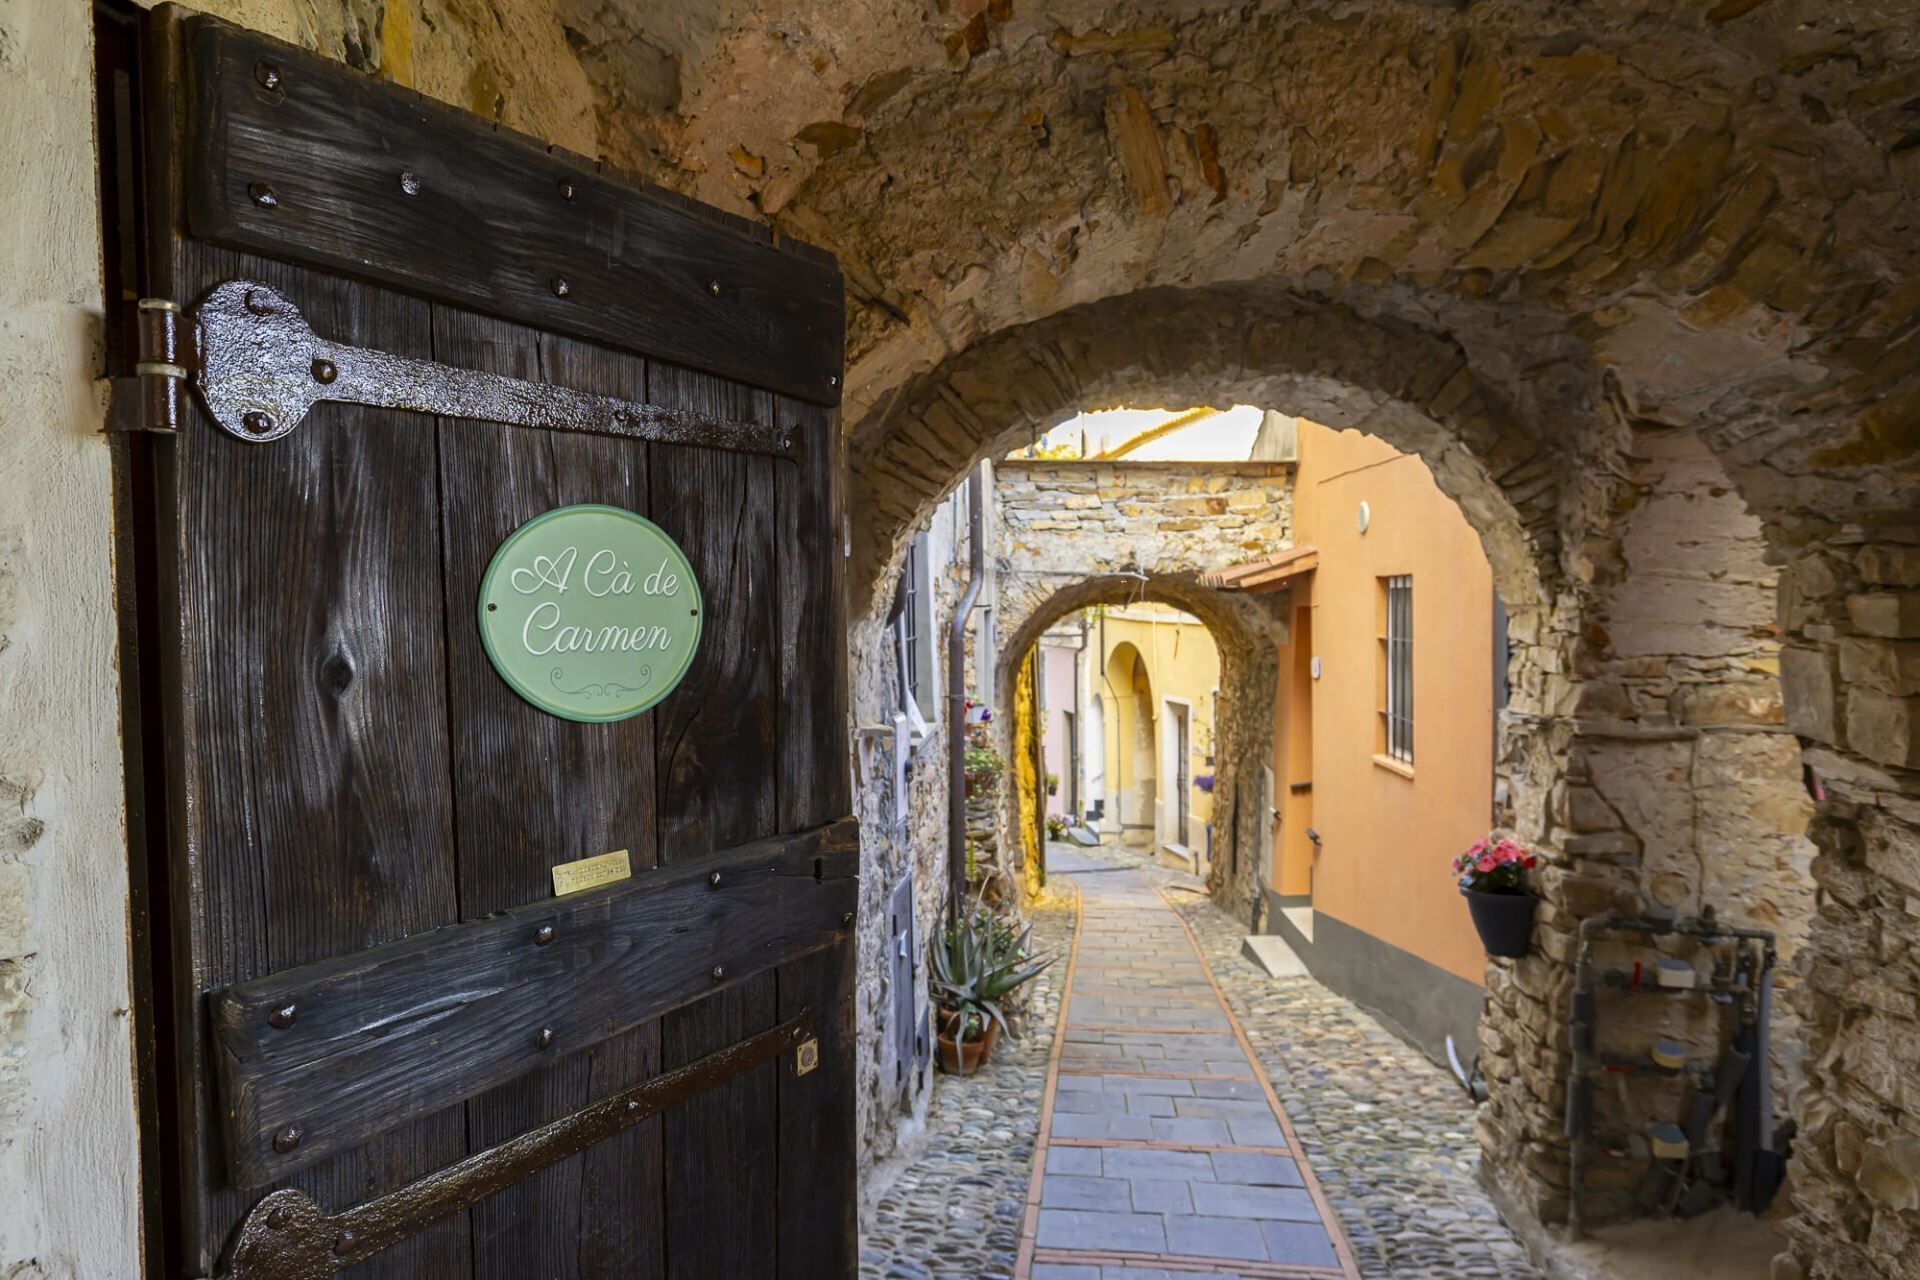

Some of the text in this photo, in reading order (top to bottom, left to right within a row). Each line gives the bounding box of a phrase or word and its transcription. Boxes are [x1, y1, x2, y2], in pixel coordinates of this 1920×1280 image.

[511, 546, 680, 597] A Cà de
[522, 601, 672, 655] Carmen
